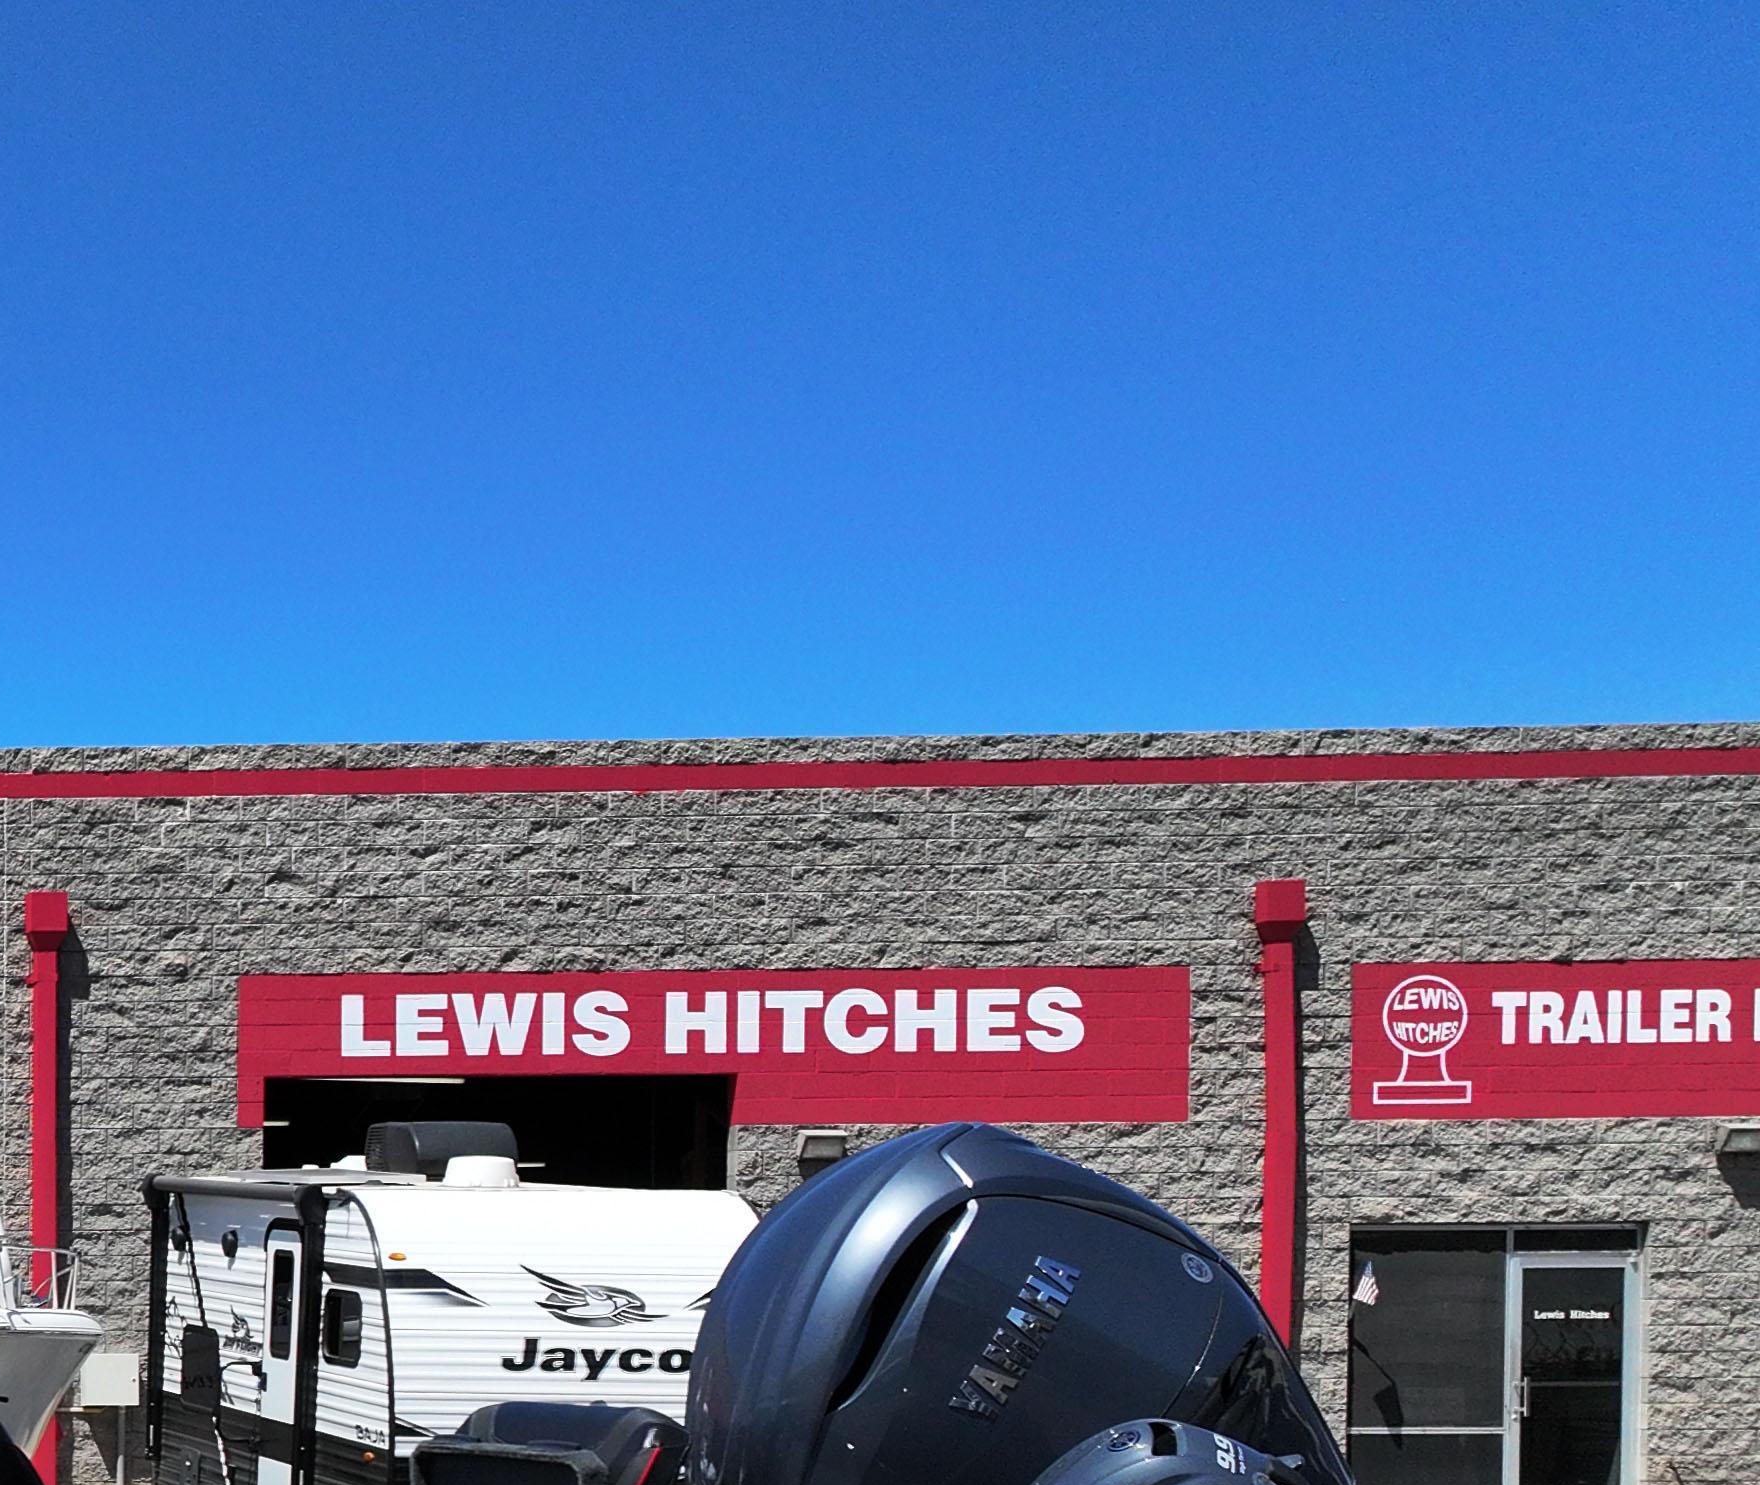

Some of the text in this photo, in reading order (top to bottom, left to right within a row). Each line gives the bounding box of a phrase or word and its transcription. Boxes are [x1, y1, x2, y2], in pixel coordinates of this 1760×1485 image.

[1392, 987, 1460, 1011] LEWIS
[1491, 988, 1732, 1044] TRAILER
[341, 986, 1085, 1057] LEWIS HITCHES
[1392, 1020, 1460, 1045] HITCHES
[1534, 1309, 1611, 1320] Lewis Hitches
[948, 1255, 1081, 1423] YAMAHA
[500, 1336, 694, 1383] Jayco
[354, 1423, 386, 1447] BAJA
